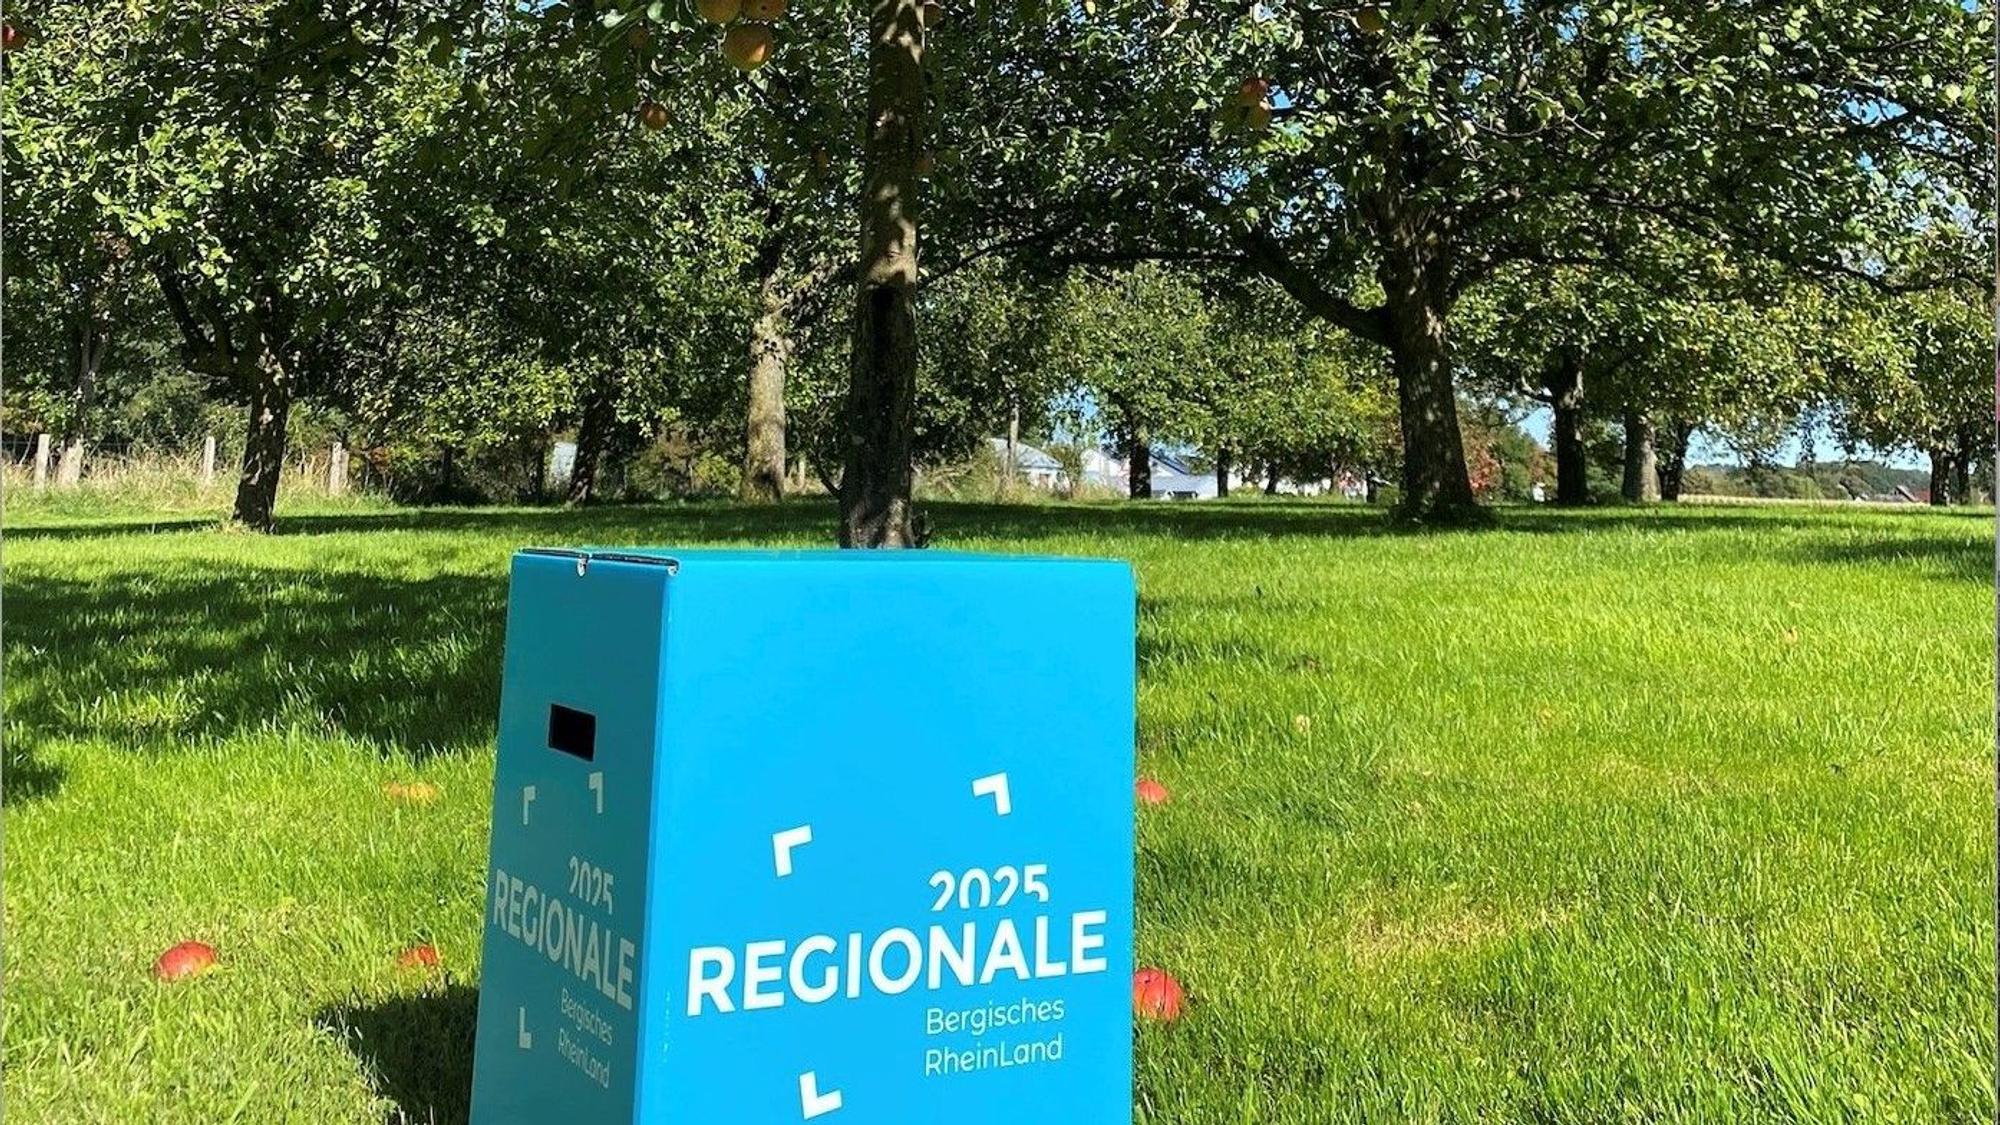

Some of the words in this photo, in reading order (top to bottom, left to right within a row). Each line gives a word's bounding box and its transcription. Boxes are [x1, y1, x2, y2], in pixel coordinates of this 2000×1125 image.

[928, 864, 1049, 911] 2025
[493, 868, 636, 1011] REGIONALE
[686, 909, 1108, 1017] REGIONALE
[561, 988, 614, 1047] Bergisches
[926, 996, 1065, 1037] Bergisches
[924, 1033, 1063, 1077] RheinLand
